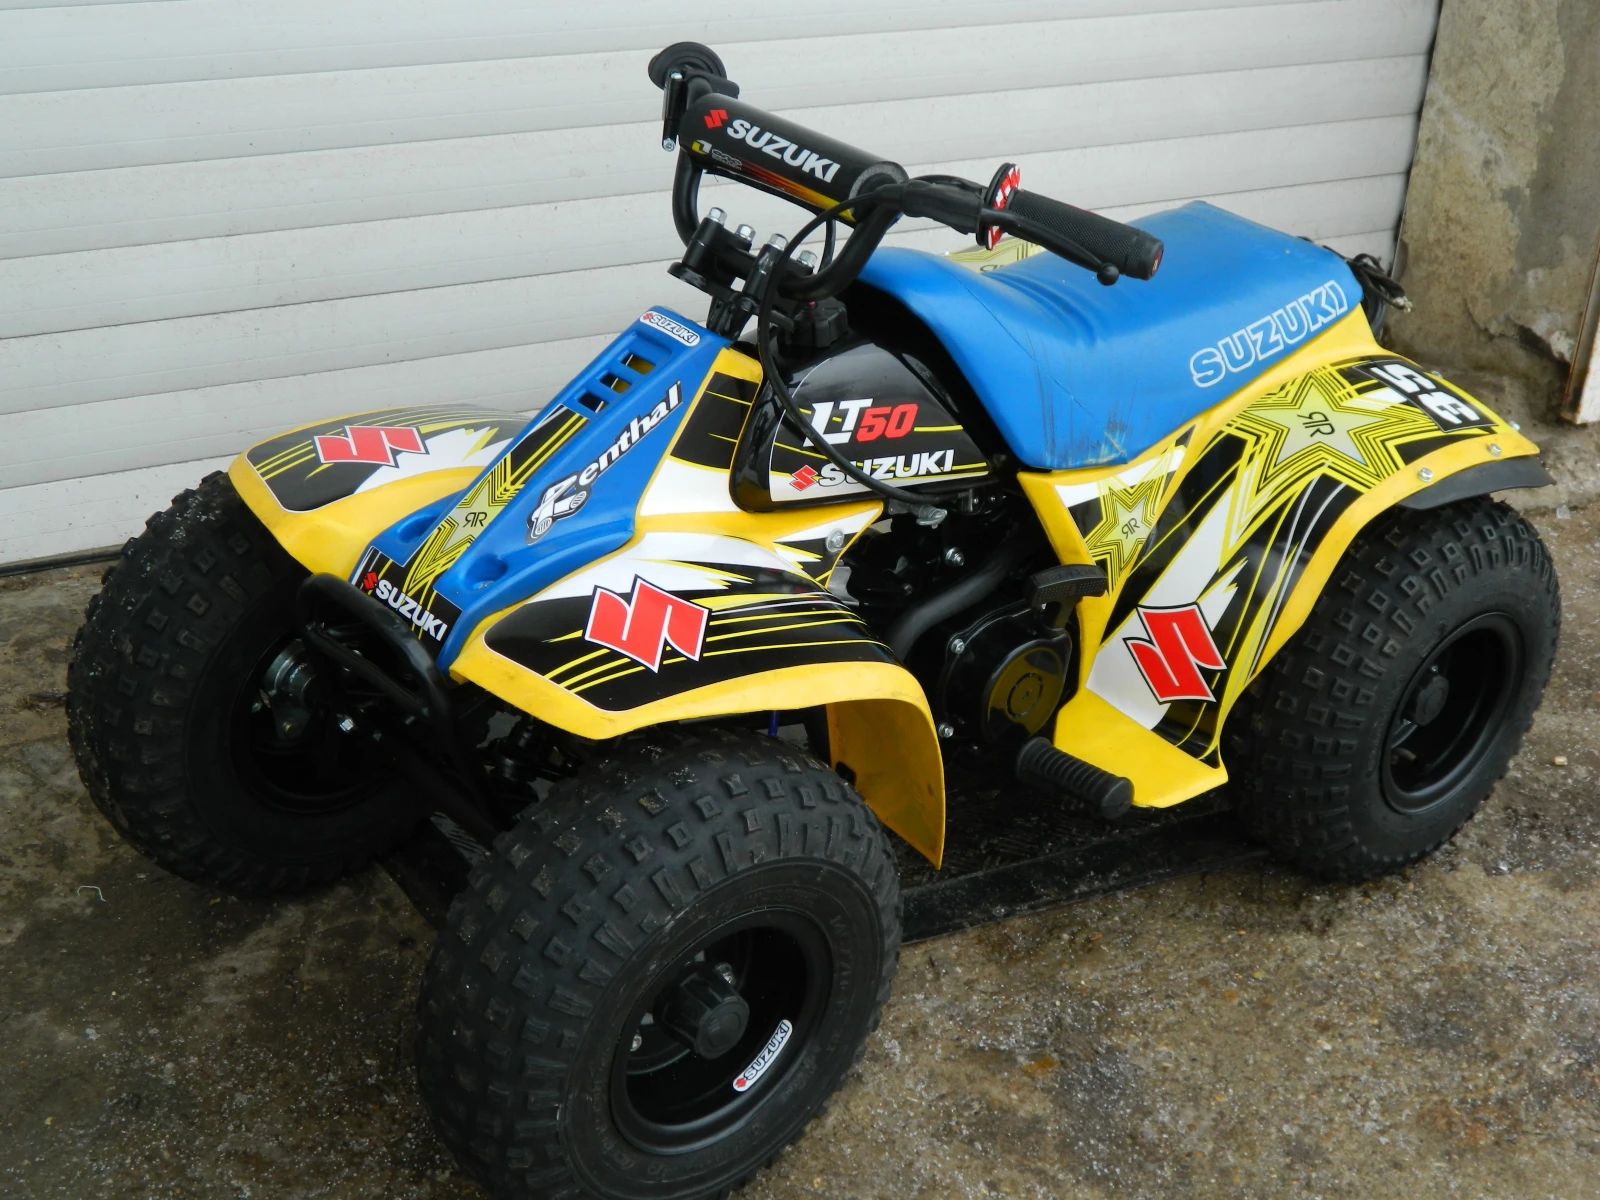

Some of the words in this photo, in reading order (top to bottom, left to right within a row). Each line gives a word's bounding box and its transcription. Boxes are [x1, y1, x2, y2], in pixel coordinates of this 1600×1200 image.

[726, 118, 841, 184] SUZUKI
[649, 314, 699, 344] SUZUKI
[1189, 279, 1349, 388] SUZUKI
[818, 449, 955, 488] SUZUKI
[375, 579, 448, 642] SUZUKI
[743, 1021, 790, 1081] SUZUKI
